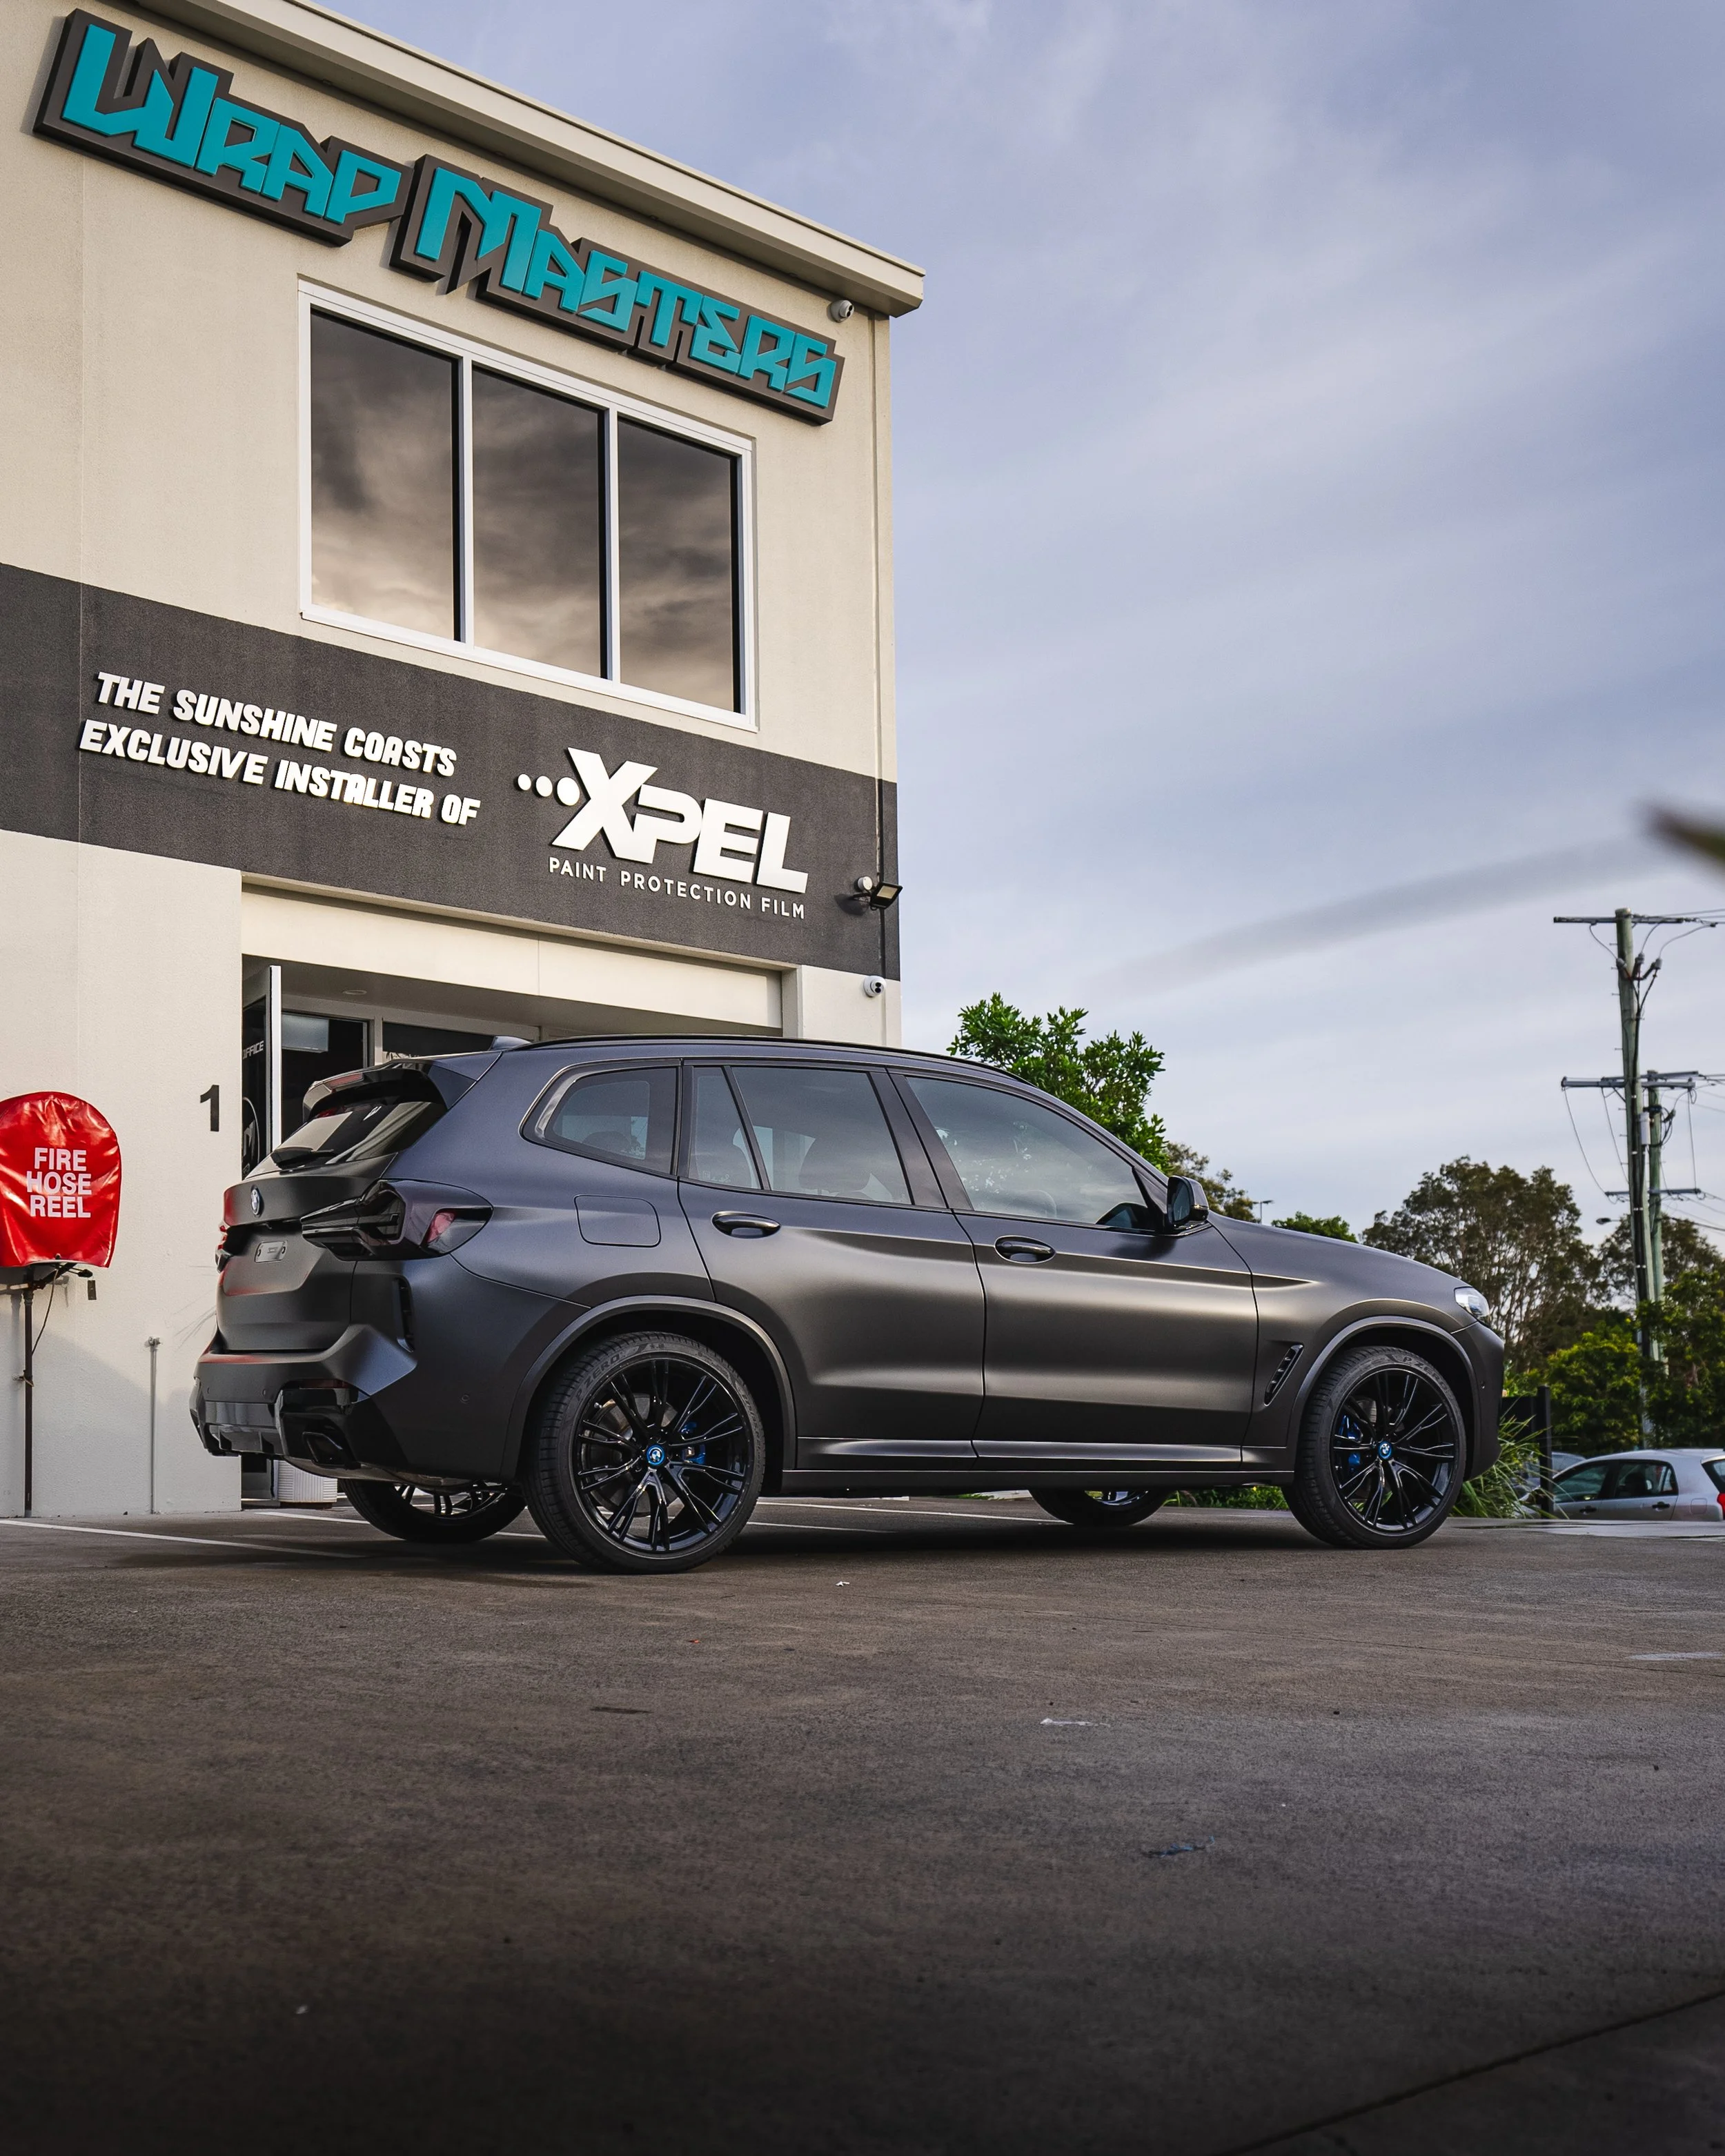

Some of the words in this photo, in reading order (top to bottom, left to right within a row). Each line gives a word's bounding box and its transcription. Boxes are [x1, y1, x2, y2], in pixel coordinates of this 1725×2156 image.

[62, 24, 402, 224] WRAP
[415, 166, 836, 408] MASTERS
[97, 671, 165, 715] THE
[172, 689, 338, 753] SUNSHINE
[344, 727, 457, 777] COASTS
[79, 718, 269, 785] EXCLUSIVE
[275, 759, 434, 818] INSTALLER
[441, 793, 482, 826] OF
[552, 746, 809, 893] XPEL
[549, 857, 607, 883] PAINT
[621, 870, 751, 910] PROTECTION
[761, 897, 805, 920] FILM
[199, 1084, 220, 1132] 1
[26, 1171, 92, 1195] HOSE
[34, 1147, 87, 1171] FIRE
[30, 1195, 91, 1218] REEL
